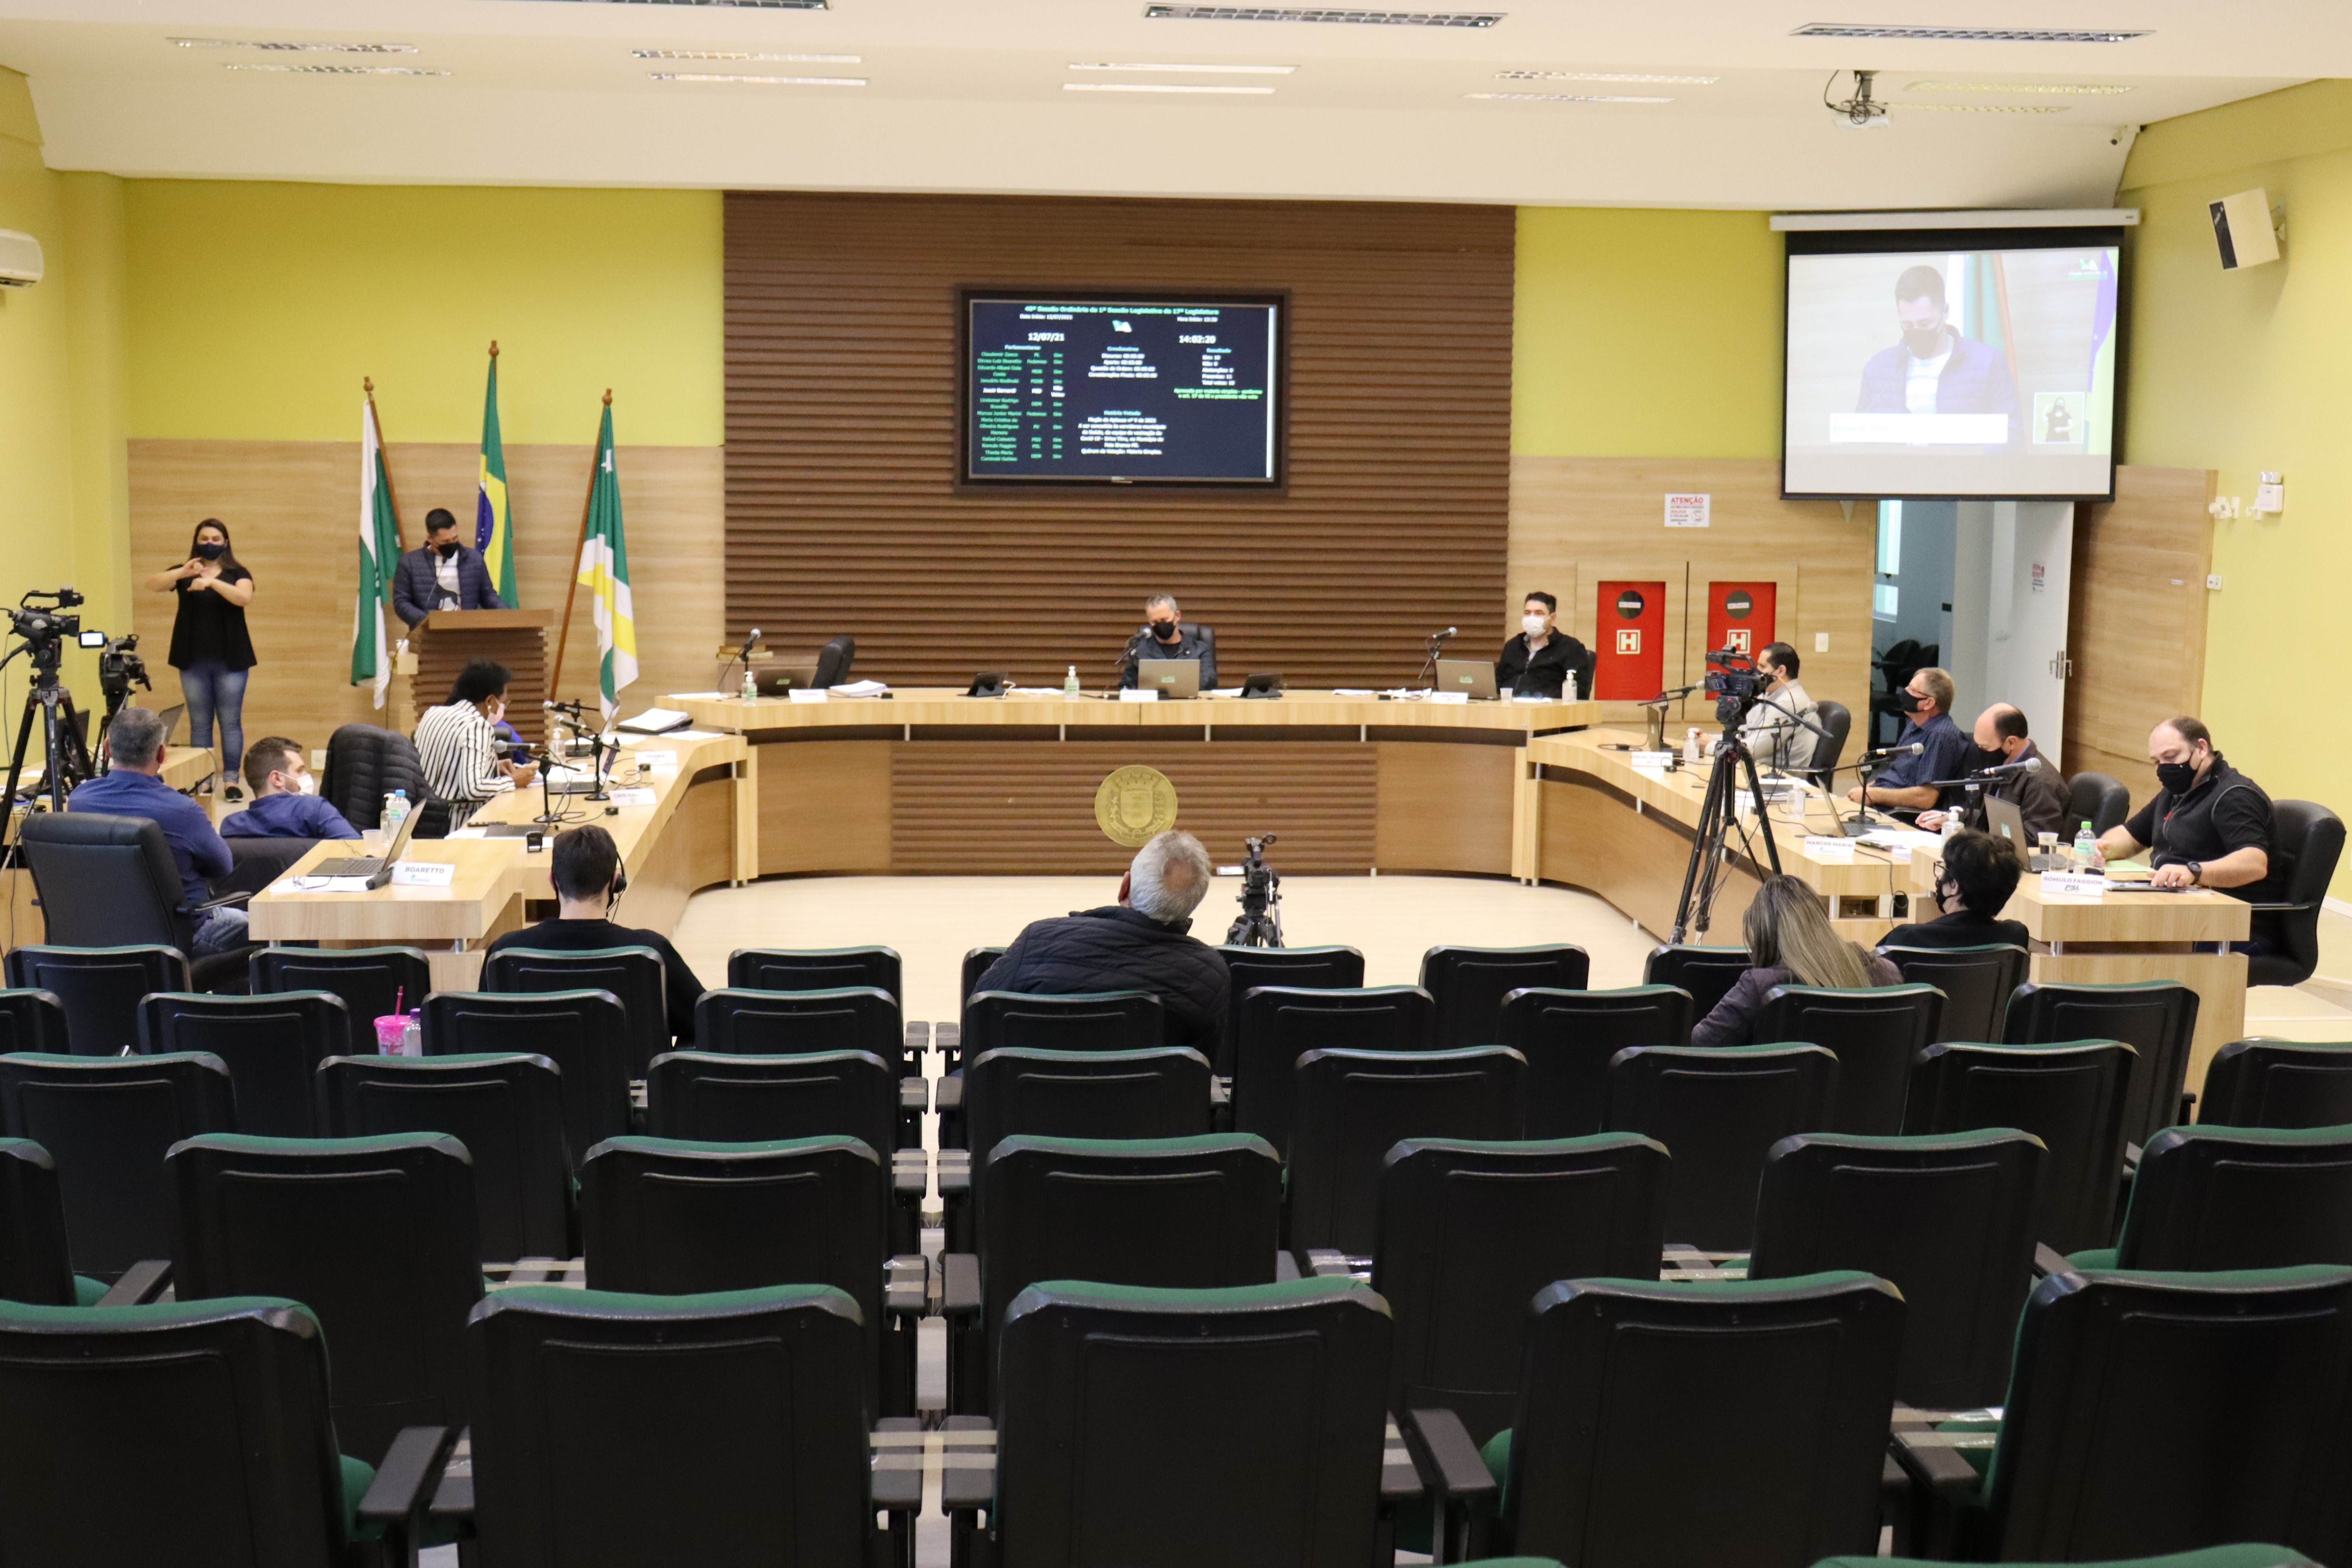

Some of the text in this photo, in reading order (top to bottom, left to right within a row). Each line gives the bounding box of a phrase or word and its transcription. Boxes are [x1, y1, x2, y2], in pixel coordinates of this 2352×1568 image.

[1028, 332, 1065, 342] 12/07/21
[1179, 335, 1216, 344] 14:02:20
[1671, 496, 1704, 505] ATENÇÃO
[1620, 633, 1637, 650] H
[1730, 633, 1748, 650] H
